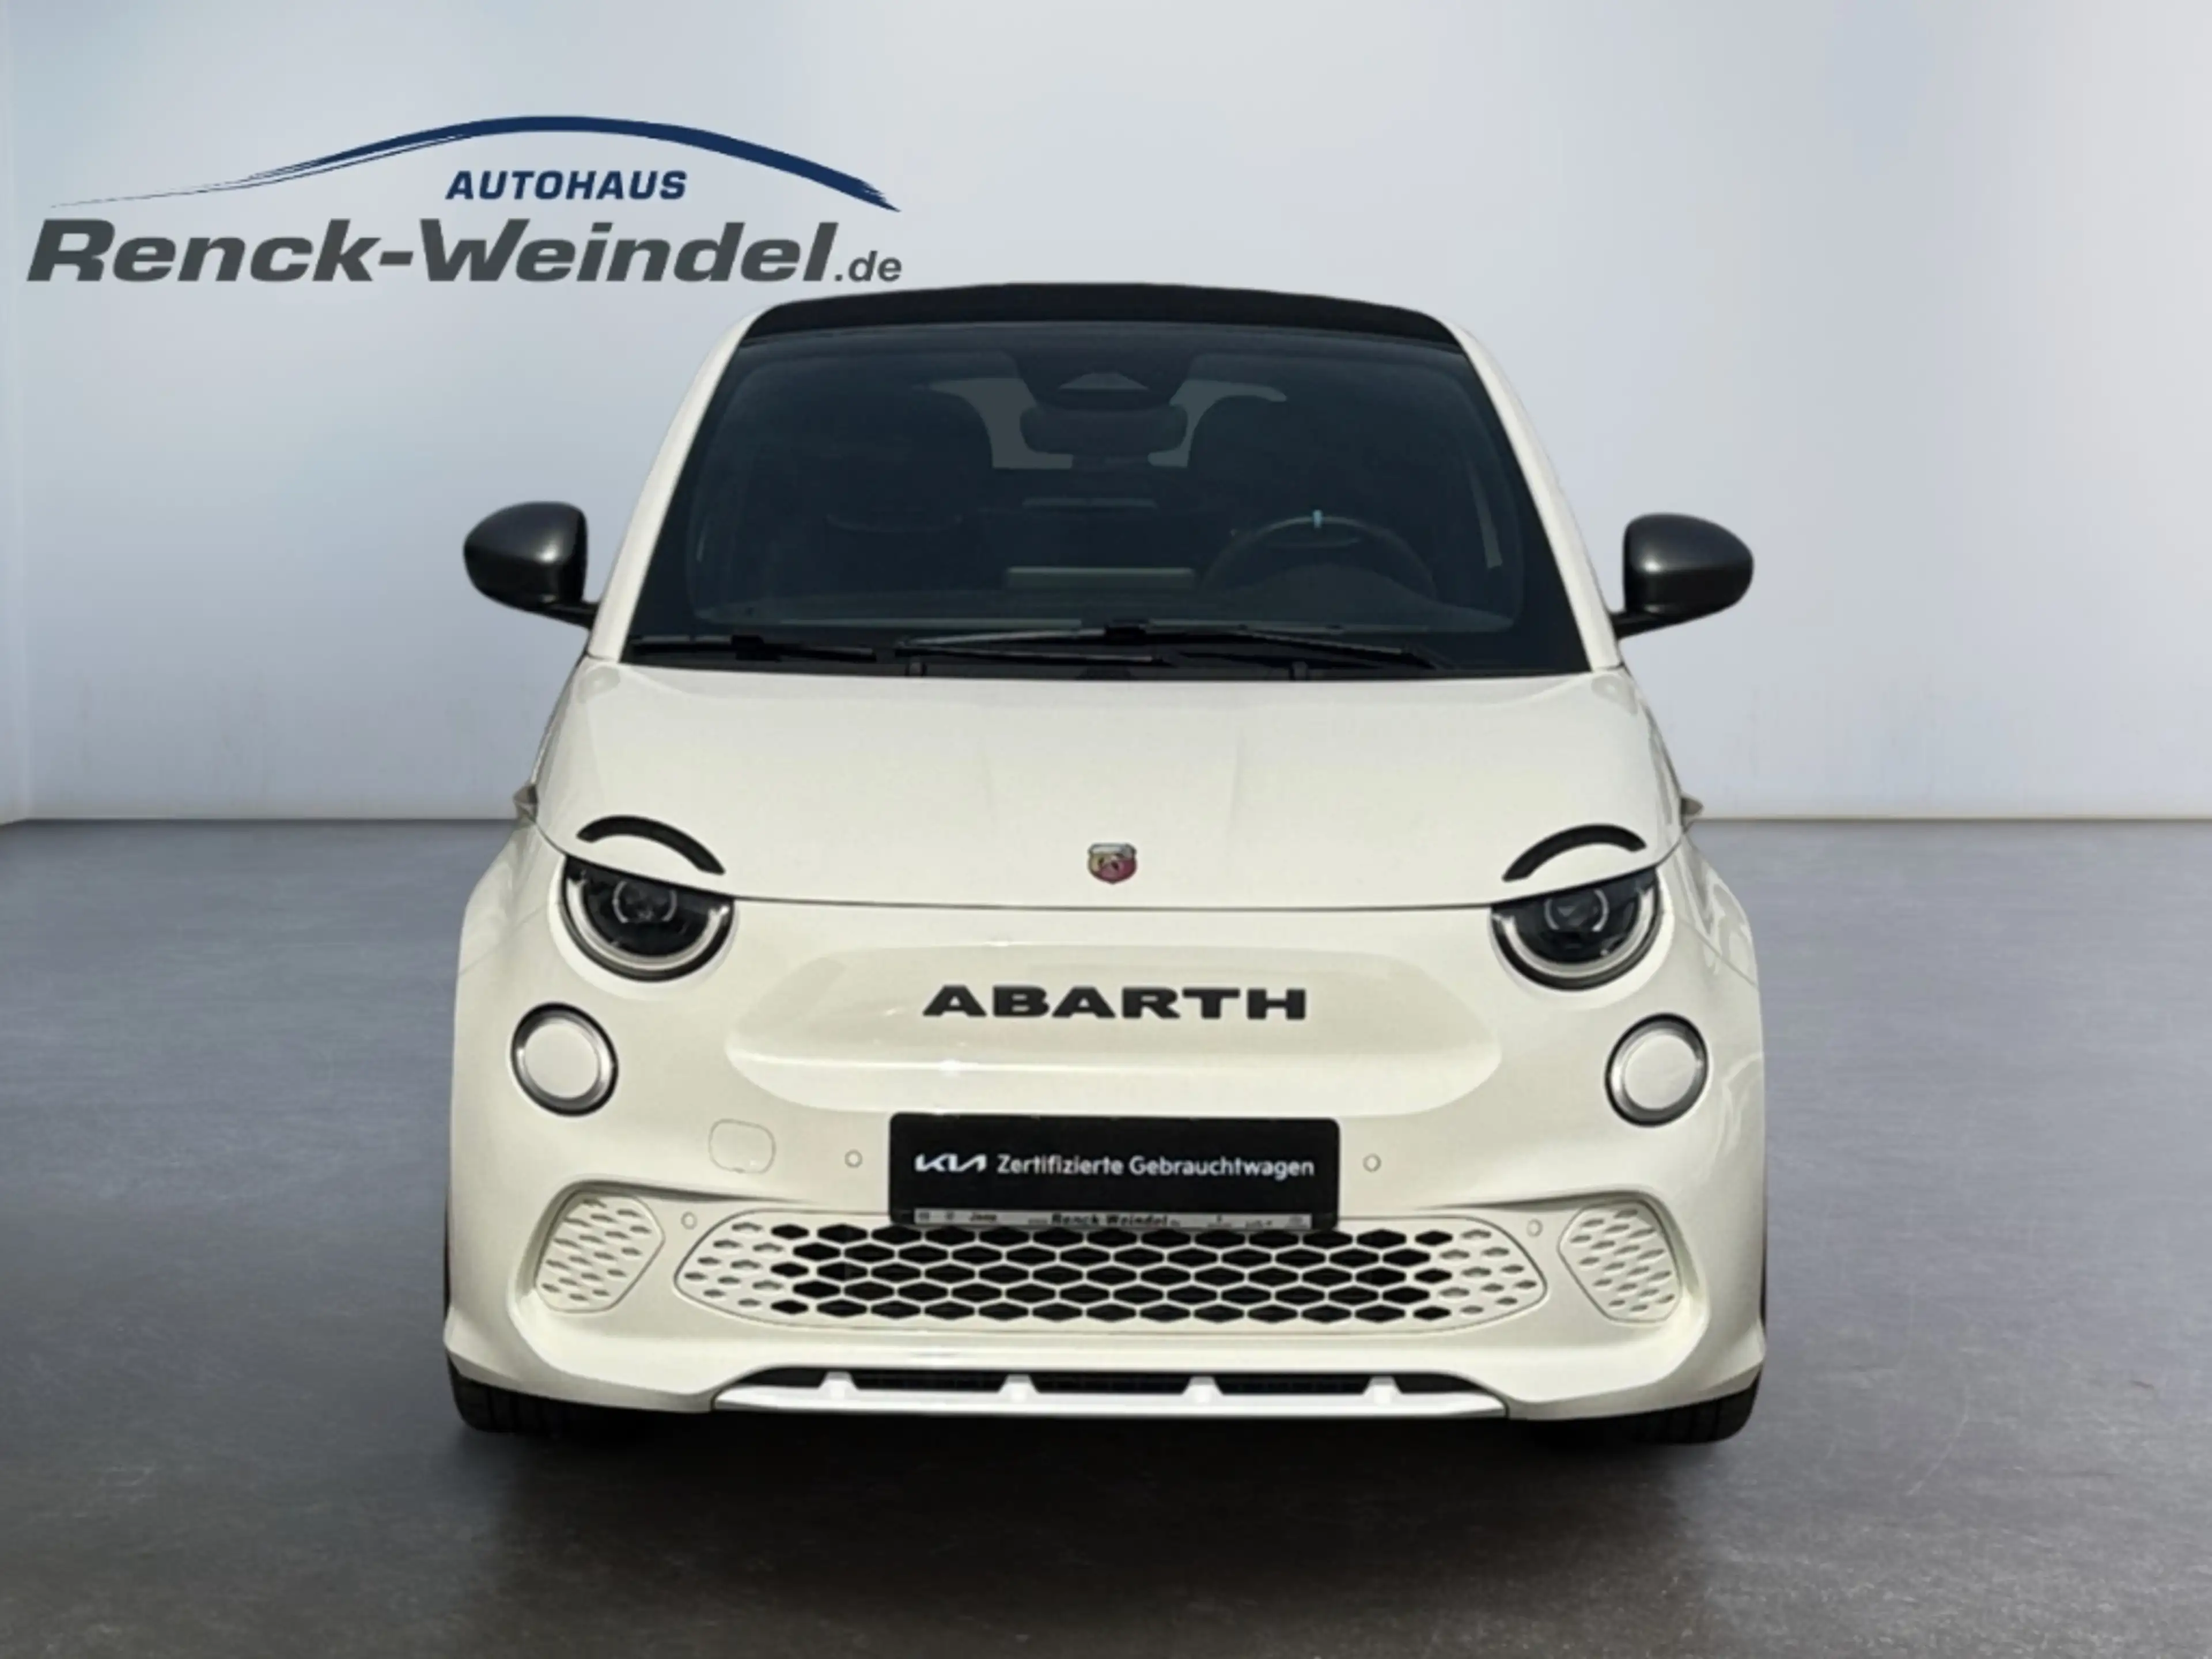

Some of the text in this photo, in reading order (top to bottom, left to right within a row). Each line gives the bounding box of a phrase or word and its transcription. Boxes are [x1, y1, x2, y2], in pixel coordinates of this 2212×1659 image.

[923, 986, 1306, 1020] ABARTH
[997, 1154, 1123, 1175] Zertifizierte
[1129, 1156, 1315, 1180] Gebrauchtwagen
